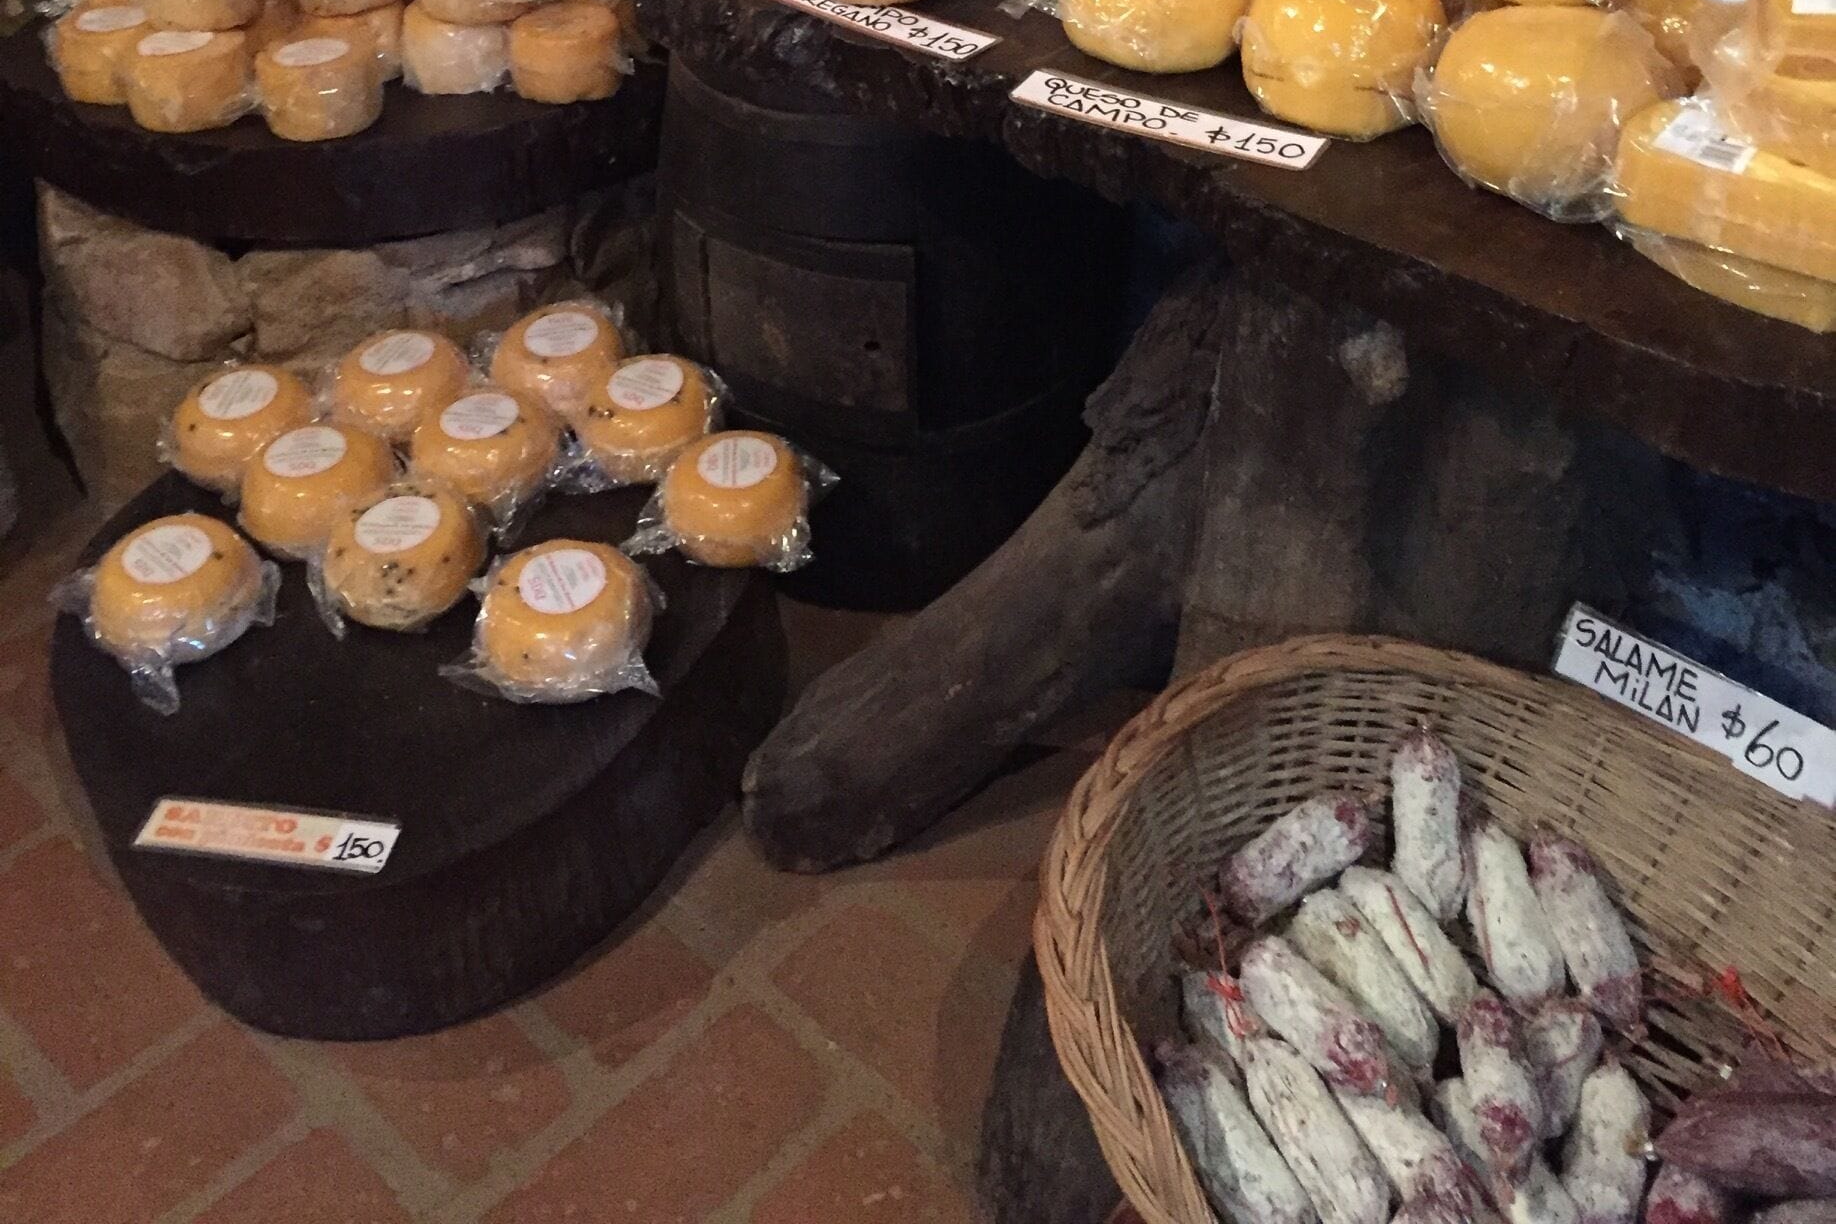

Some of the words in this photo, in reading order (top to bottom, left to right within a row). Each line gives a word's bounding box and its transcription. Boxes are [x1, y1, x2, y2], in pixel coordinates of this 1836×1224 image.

[909, 27, 978, 56] $150
[1044, 78, 1141, 109] QUESO
[1160, 105, 1199, 123] DE
[1205, 126, 1306, 159] $150
[1576, 619, 1698, 702] SALAME
[1721, 704, 1804, 781] $60
